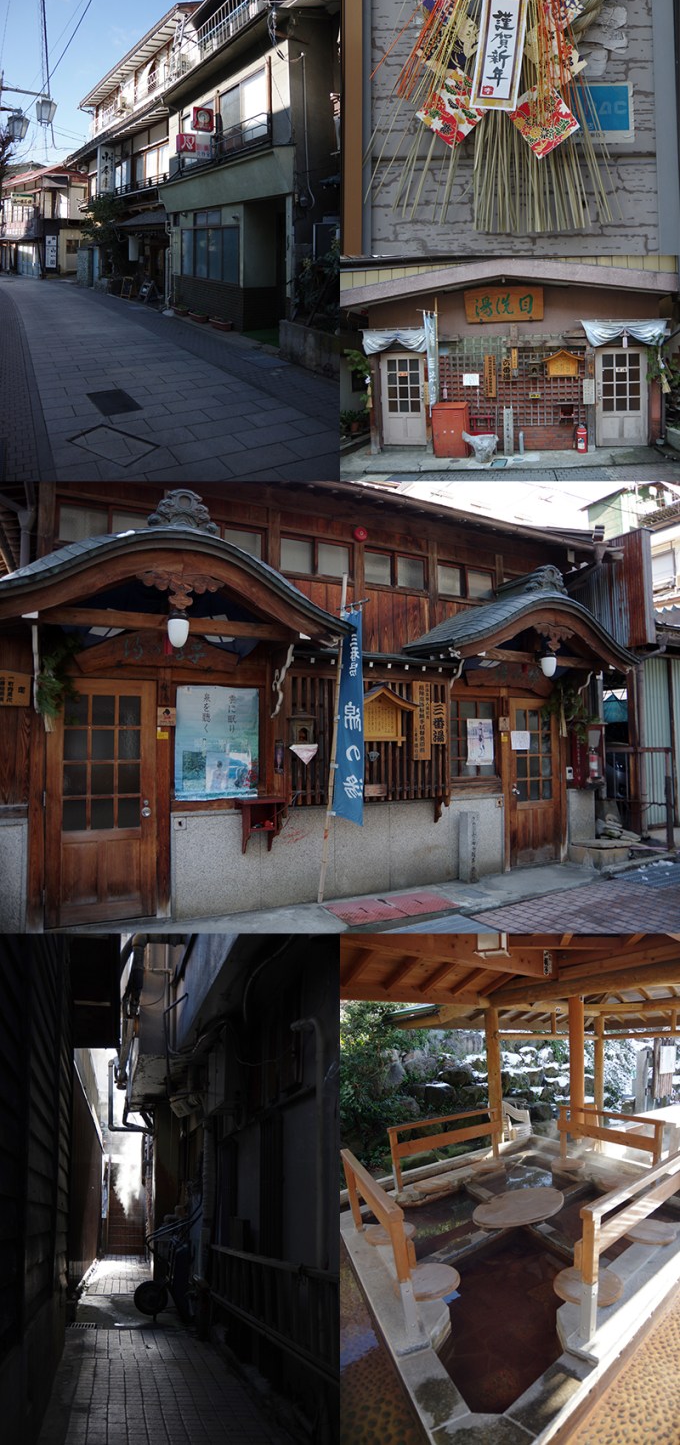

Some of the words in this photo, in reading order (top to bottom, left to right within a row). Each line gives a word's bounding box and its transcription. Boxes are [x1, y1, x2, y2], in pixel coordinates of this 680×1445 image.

[486, 10, 515, 88] 謹賀新年
[201, 691, 212, 733] 泉を聴く
[432, 703, 446, 744] 三番湯
